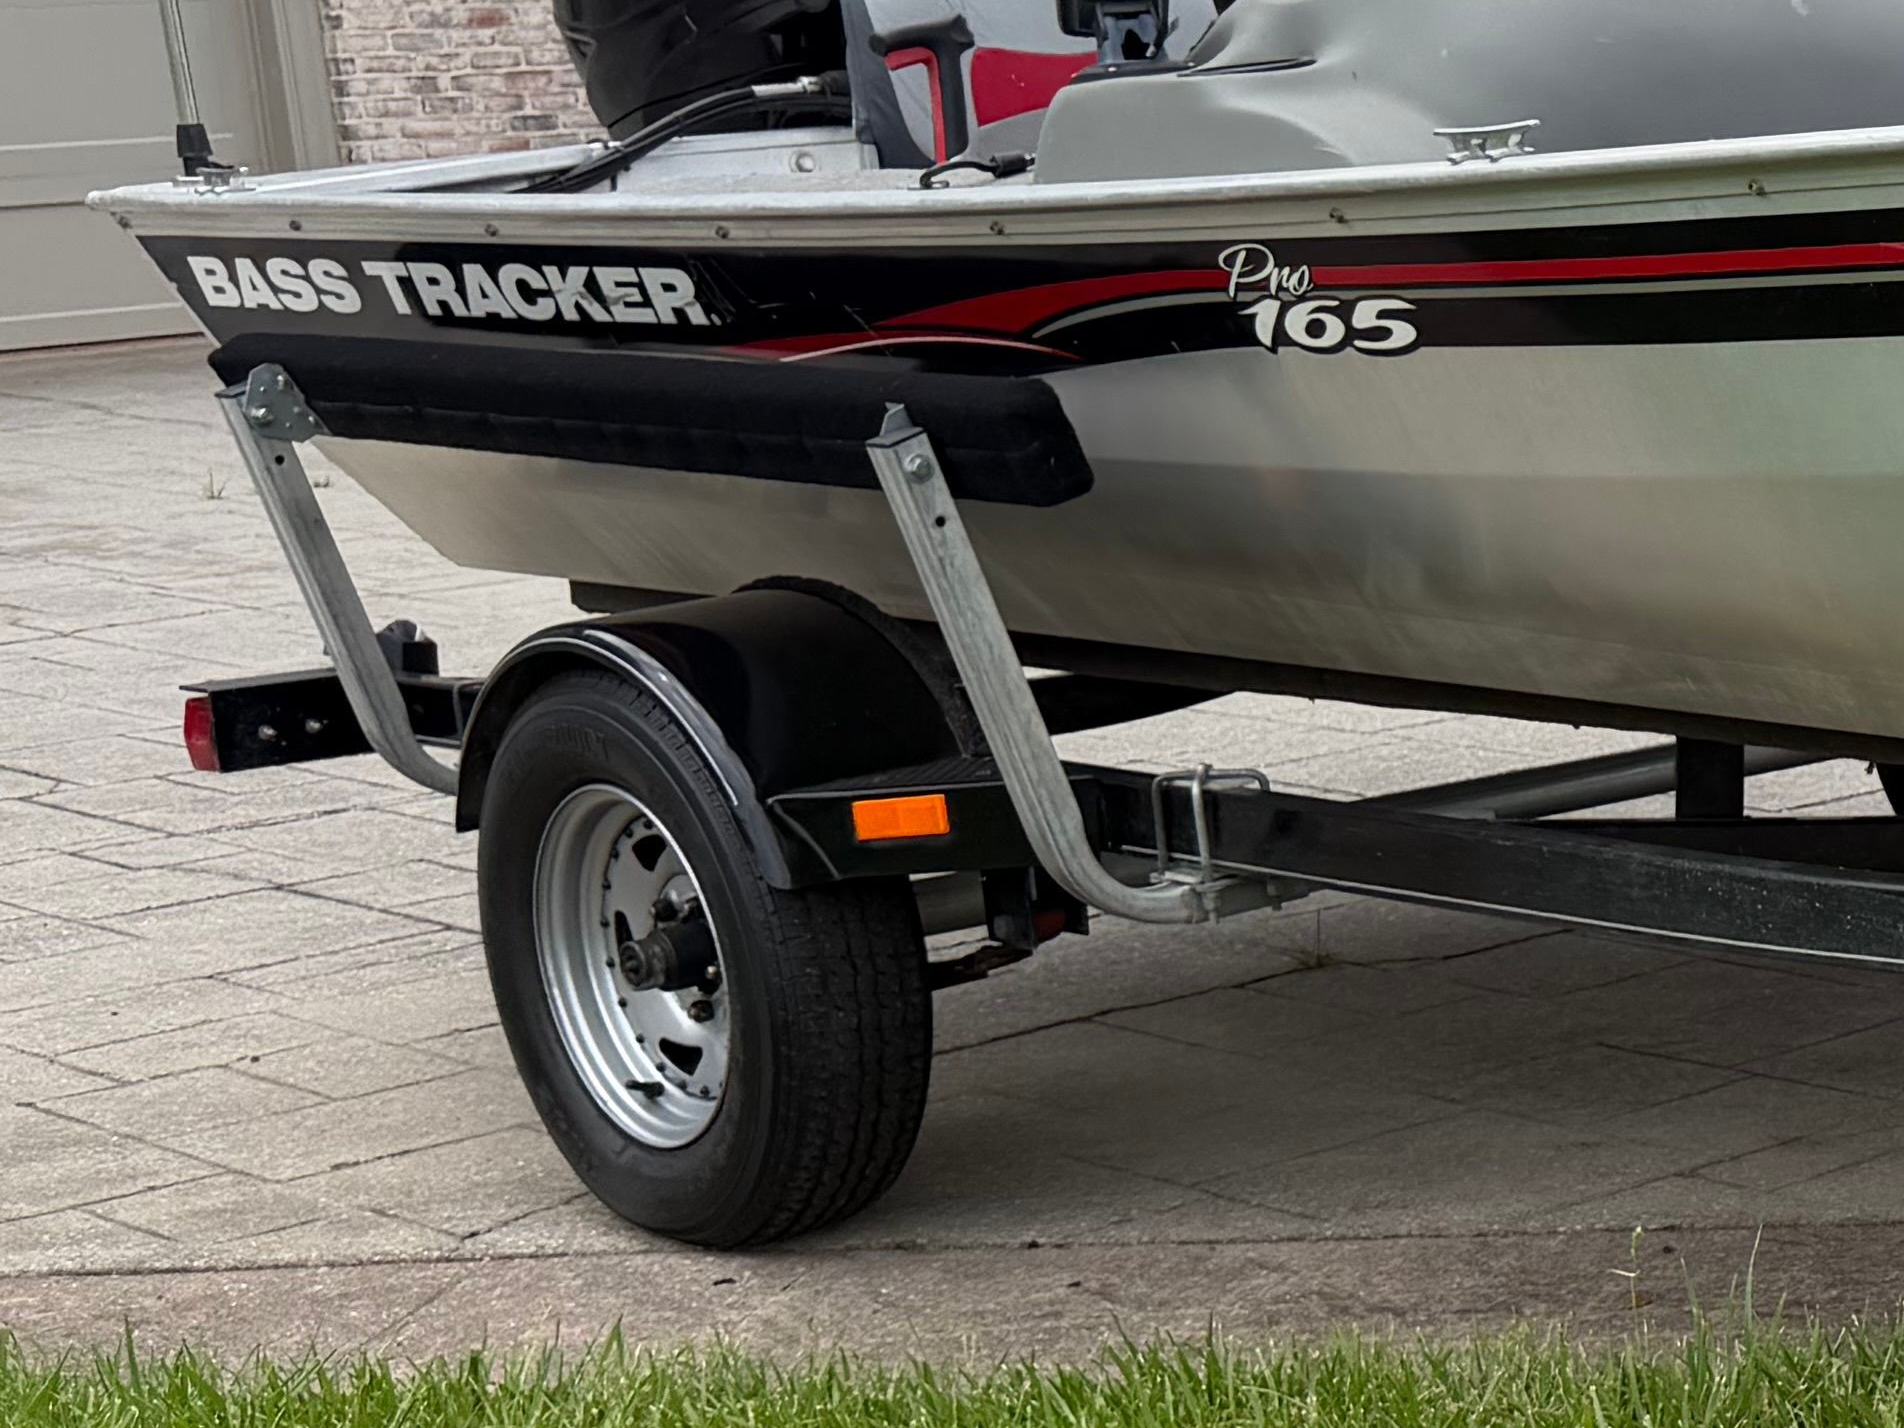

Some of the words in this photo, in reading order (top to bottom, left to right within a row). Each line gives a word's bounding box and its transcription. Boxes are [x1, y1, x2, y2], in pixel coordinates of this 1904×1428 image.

[187, 255, 362, 315] BASS
[1217, 243, 1314, 299] Pro
[1237, 298, 1418, 351] 165
